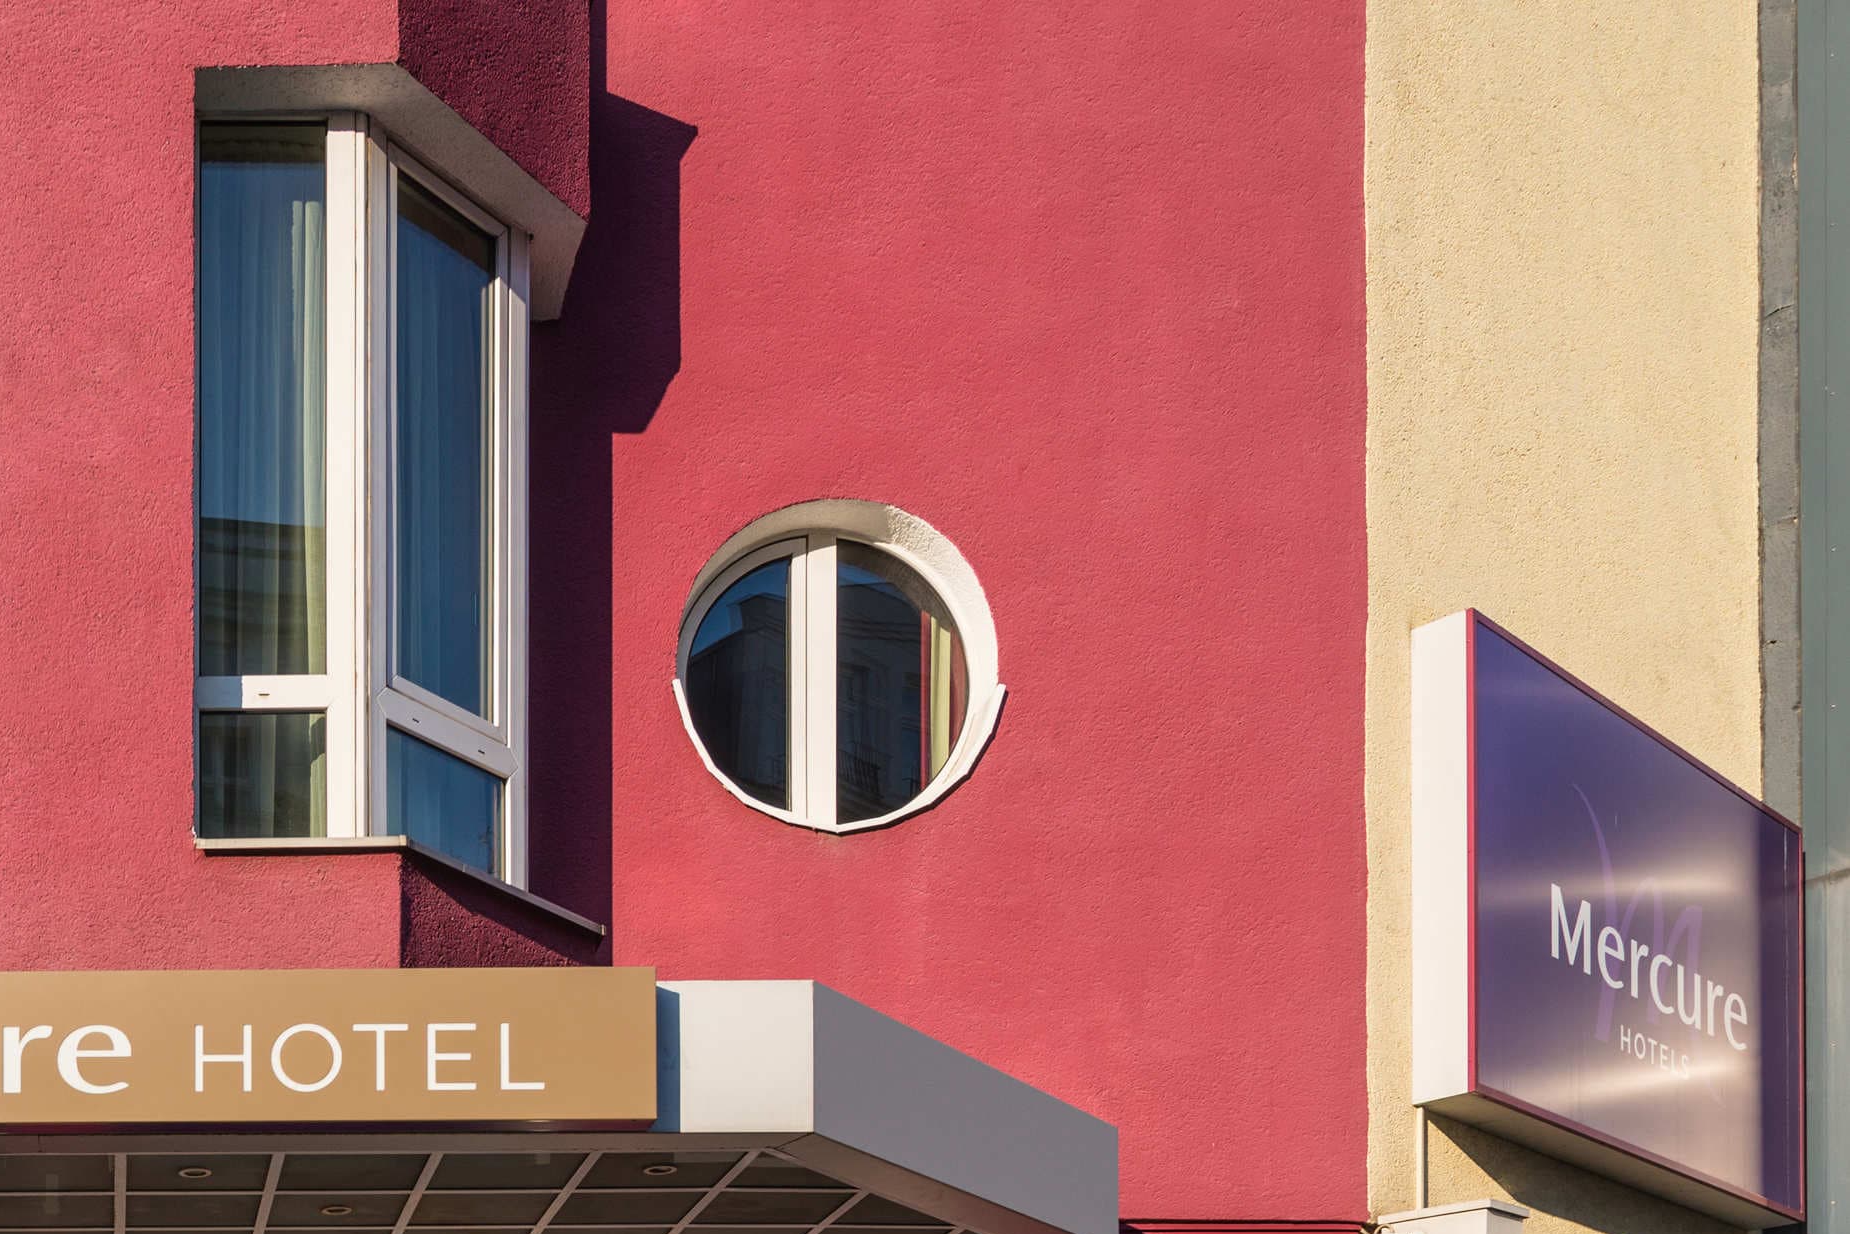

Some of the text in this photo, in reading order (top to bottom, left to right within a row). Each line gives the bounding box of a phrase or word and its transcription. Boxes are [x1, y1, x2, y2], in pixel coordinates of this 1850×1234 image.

[1550, 883, 1748, 1050] Mercure
[194, 1023, 546, 1093] HOTEL
[1620, 1024, 1690, 1080] HOTELS
